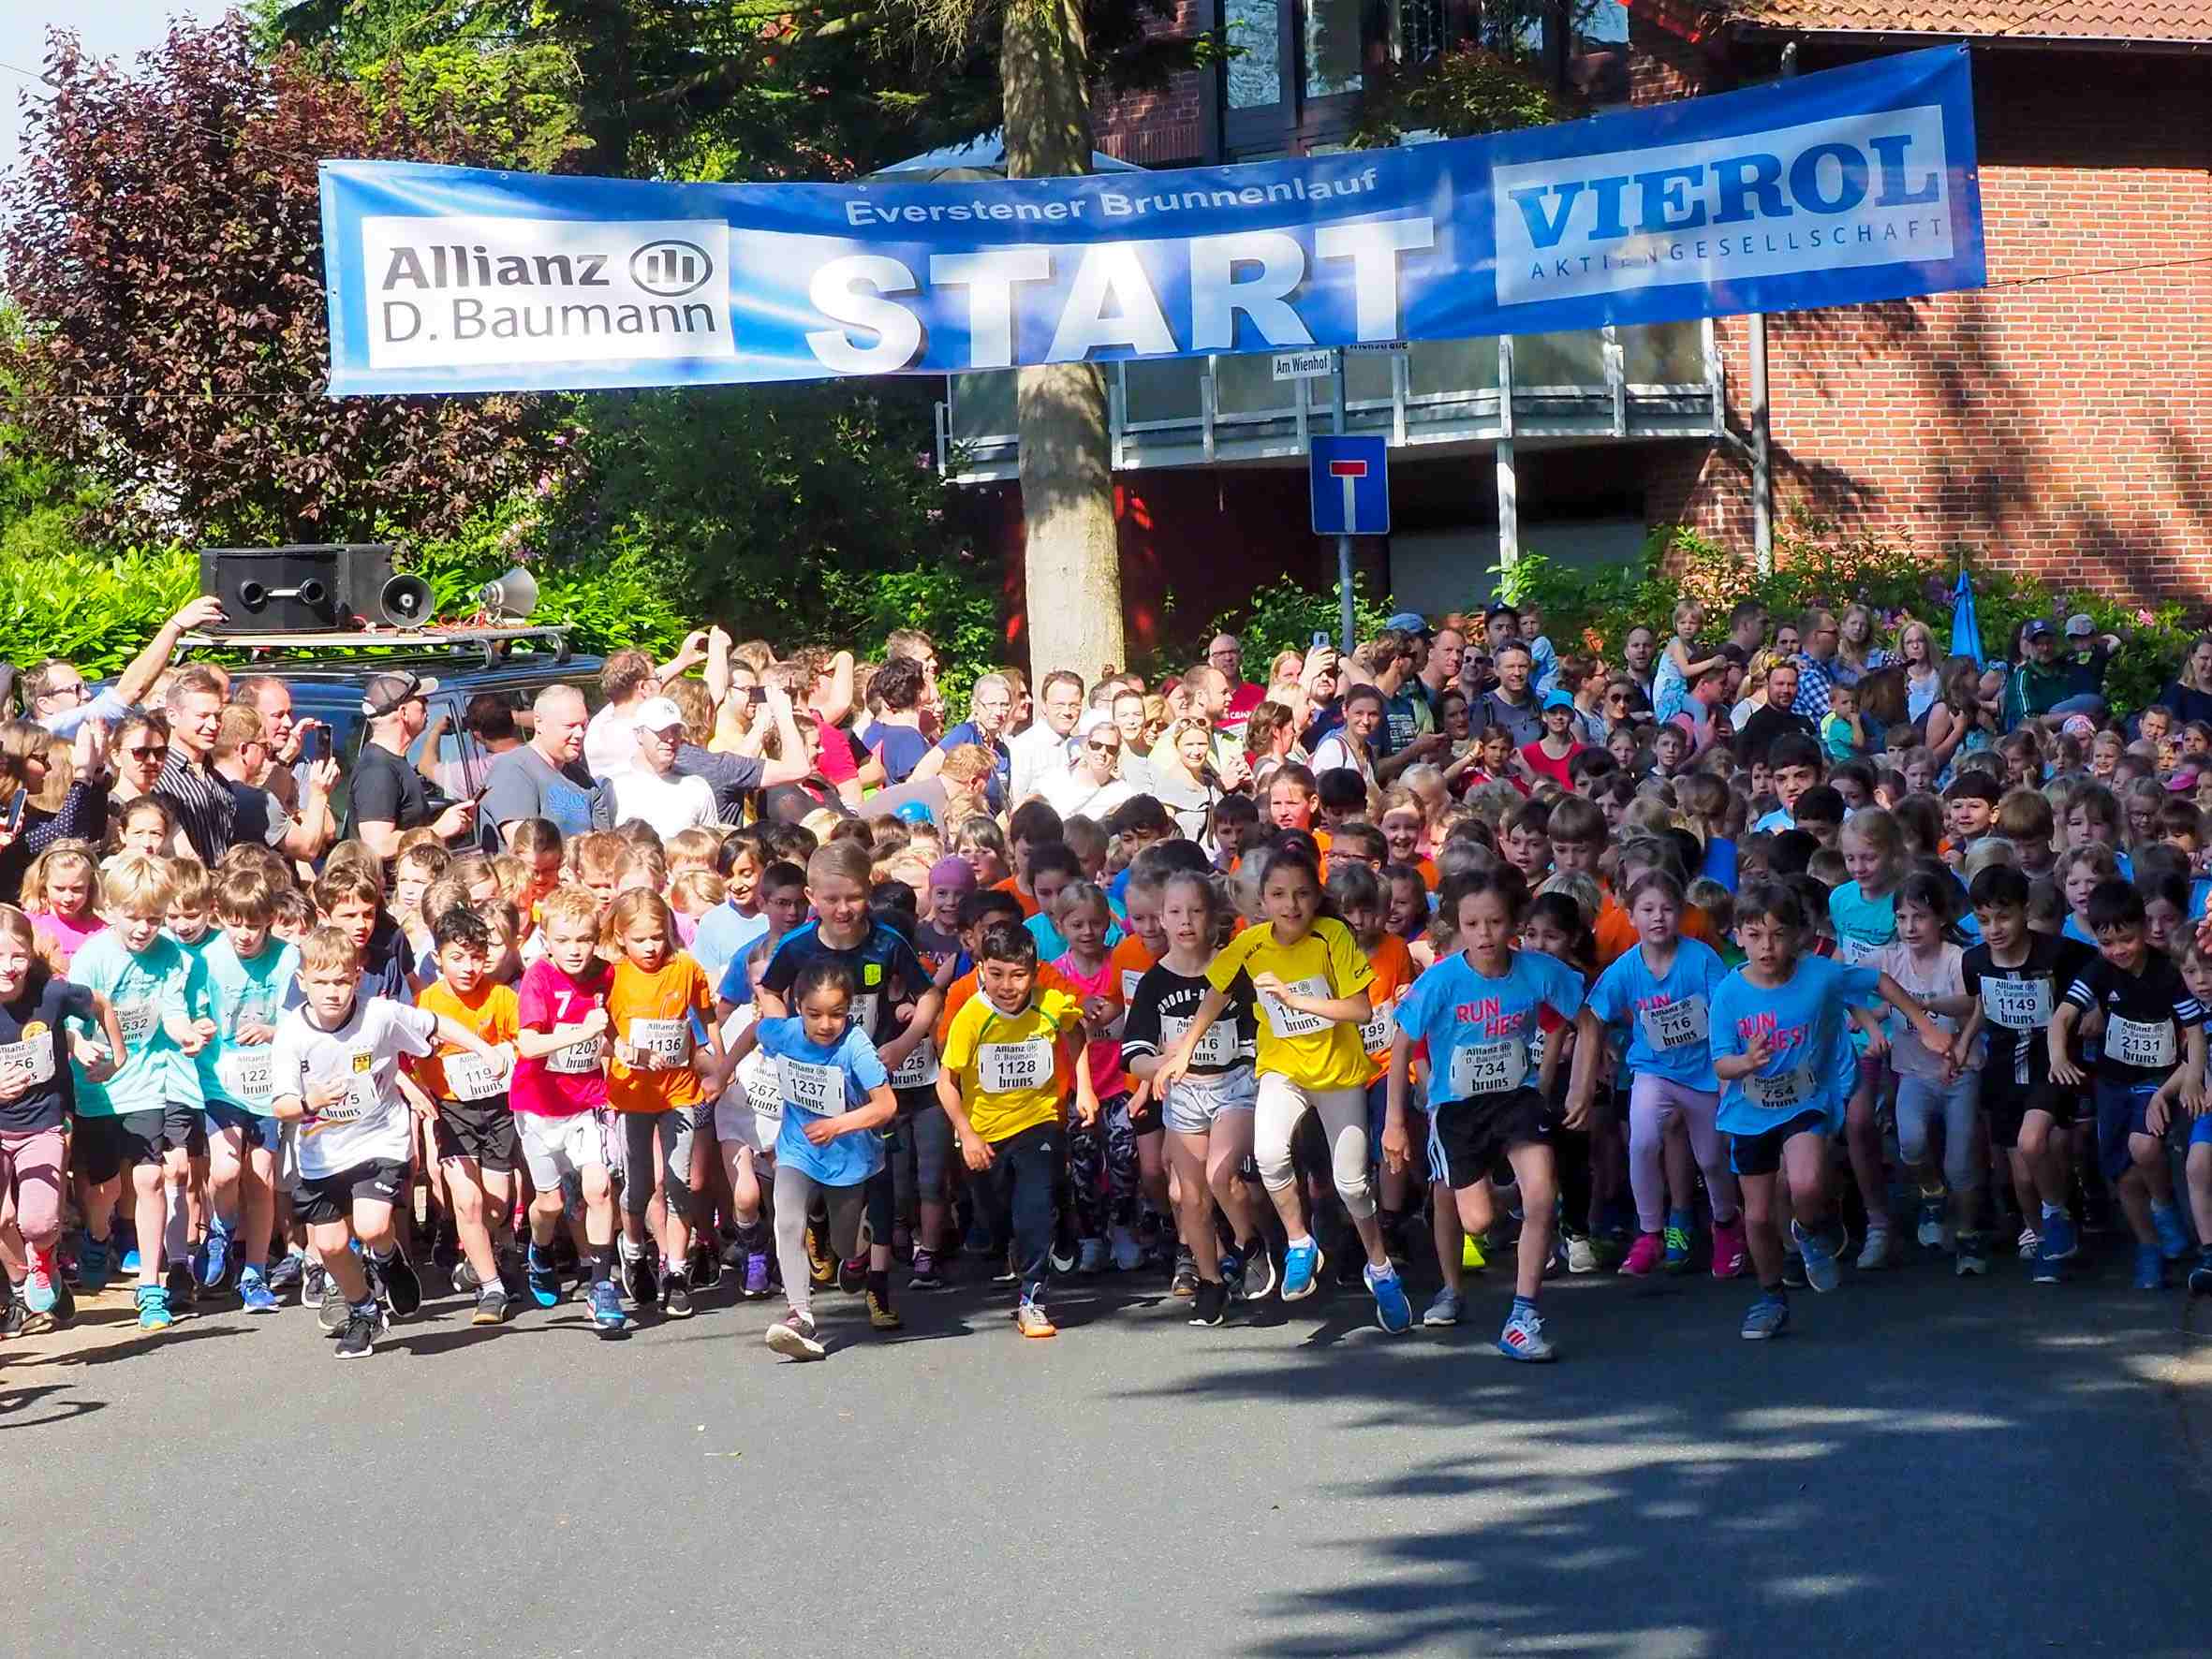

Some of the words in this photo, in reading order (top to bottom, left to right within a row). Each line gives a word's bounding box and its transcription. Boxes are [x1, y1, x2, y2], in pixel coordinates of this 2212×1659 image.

[845, 196, 1087, 227] Everstener
[1102, 168, 1378, 217] Brunnenlauf
[1509, 135, 1940, 249] VIEROL
[1530, 218, 1942, 280] AKTIENGESELLSCHAFT
[382, 245, 610, 291] Allianz
[804, 215, 1436, 376] START
[383, 301, 438, 344] D.
[453, 297, 717, 341] Baumann
[1276, 360, 1290, 374] Am
[1292, 356, 1328, 373] Wienhof
[1995, 980, 2024, 991] Allianz
[554, 990, 574, 1019] 7
[1456, 996, 1499, 1023] RUN
[1998, 997, 2036, 1011] 1149
[122, 1018, 148, 1032] 532
[1284, 1016, 1320, 1032] bruns
[2000, 1011, 2035, 1024] bruns
[1362, 1021, 1385, 1038] 199
[1660, 1017, 1691, 1035] 716
[2123, 1021, 2152, 1033] Allianz
[648, 1037, 682, 1053] 1136
[1662, 1031, 1697, 1047] bruns
[2121, 1036, 2160, 1051] 2131
[995, 1045, 1025, 1053] Allianz
[1466, 1046, 1497, 1058] Allianz
[2124, 1049, 2158, 1064] bruns
[465, 1067, 493, 1083] 119
[997, 1060, 1036, 1075] 1128
[1473, 1061, 1506, 1078] 734
[240, 1069, 268, 1083] 122
[999, 1076, 1034, 1088] bruns
[470, 1080, 503, 1095] bruns
[748, 1081, 784, 1100] 267
[790, 1078, 826, 1097] 1237
[1471, 1077, 1509, 1092] bruns
[794, 1091, 825, 1110] bruns
